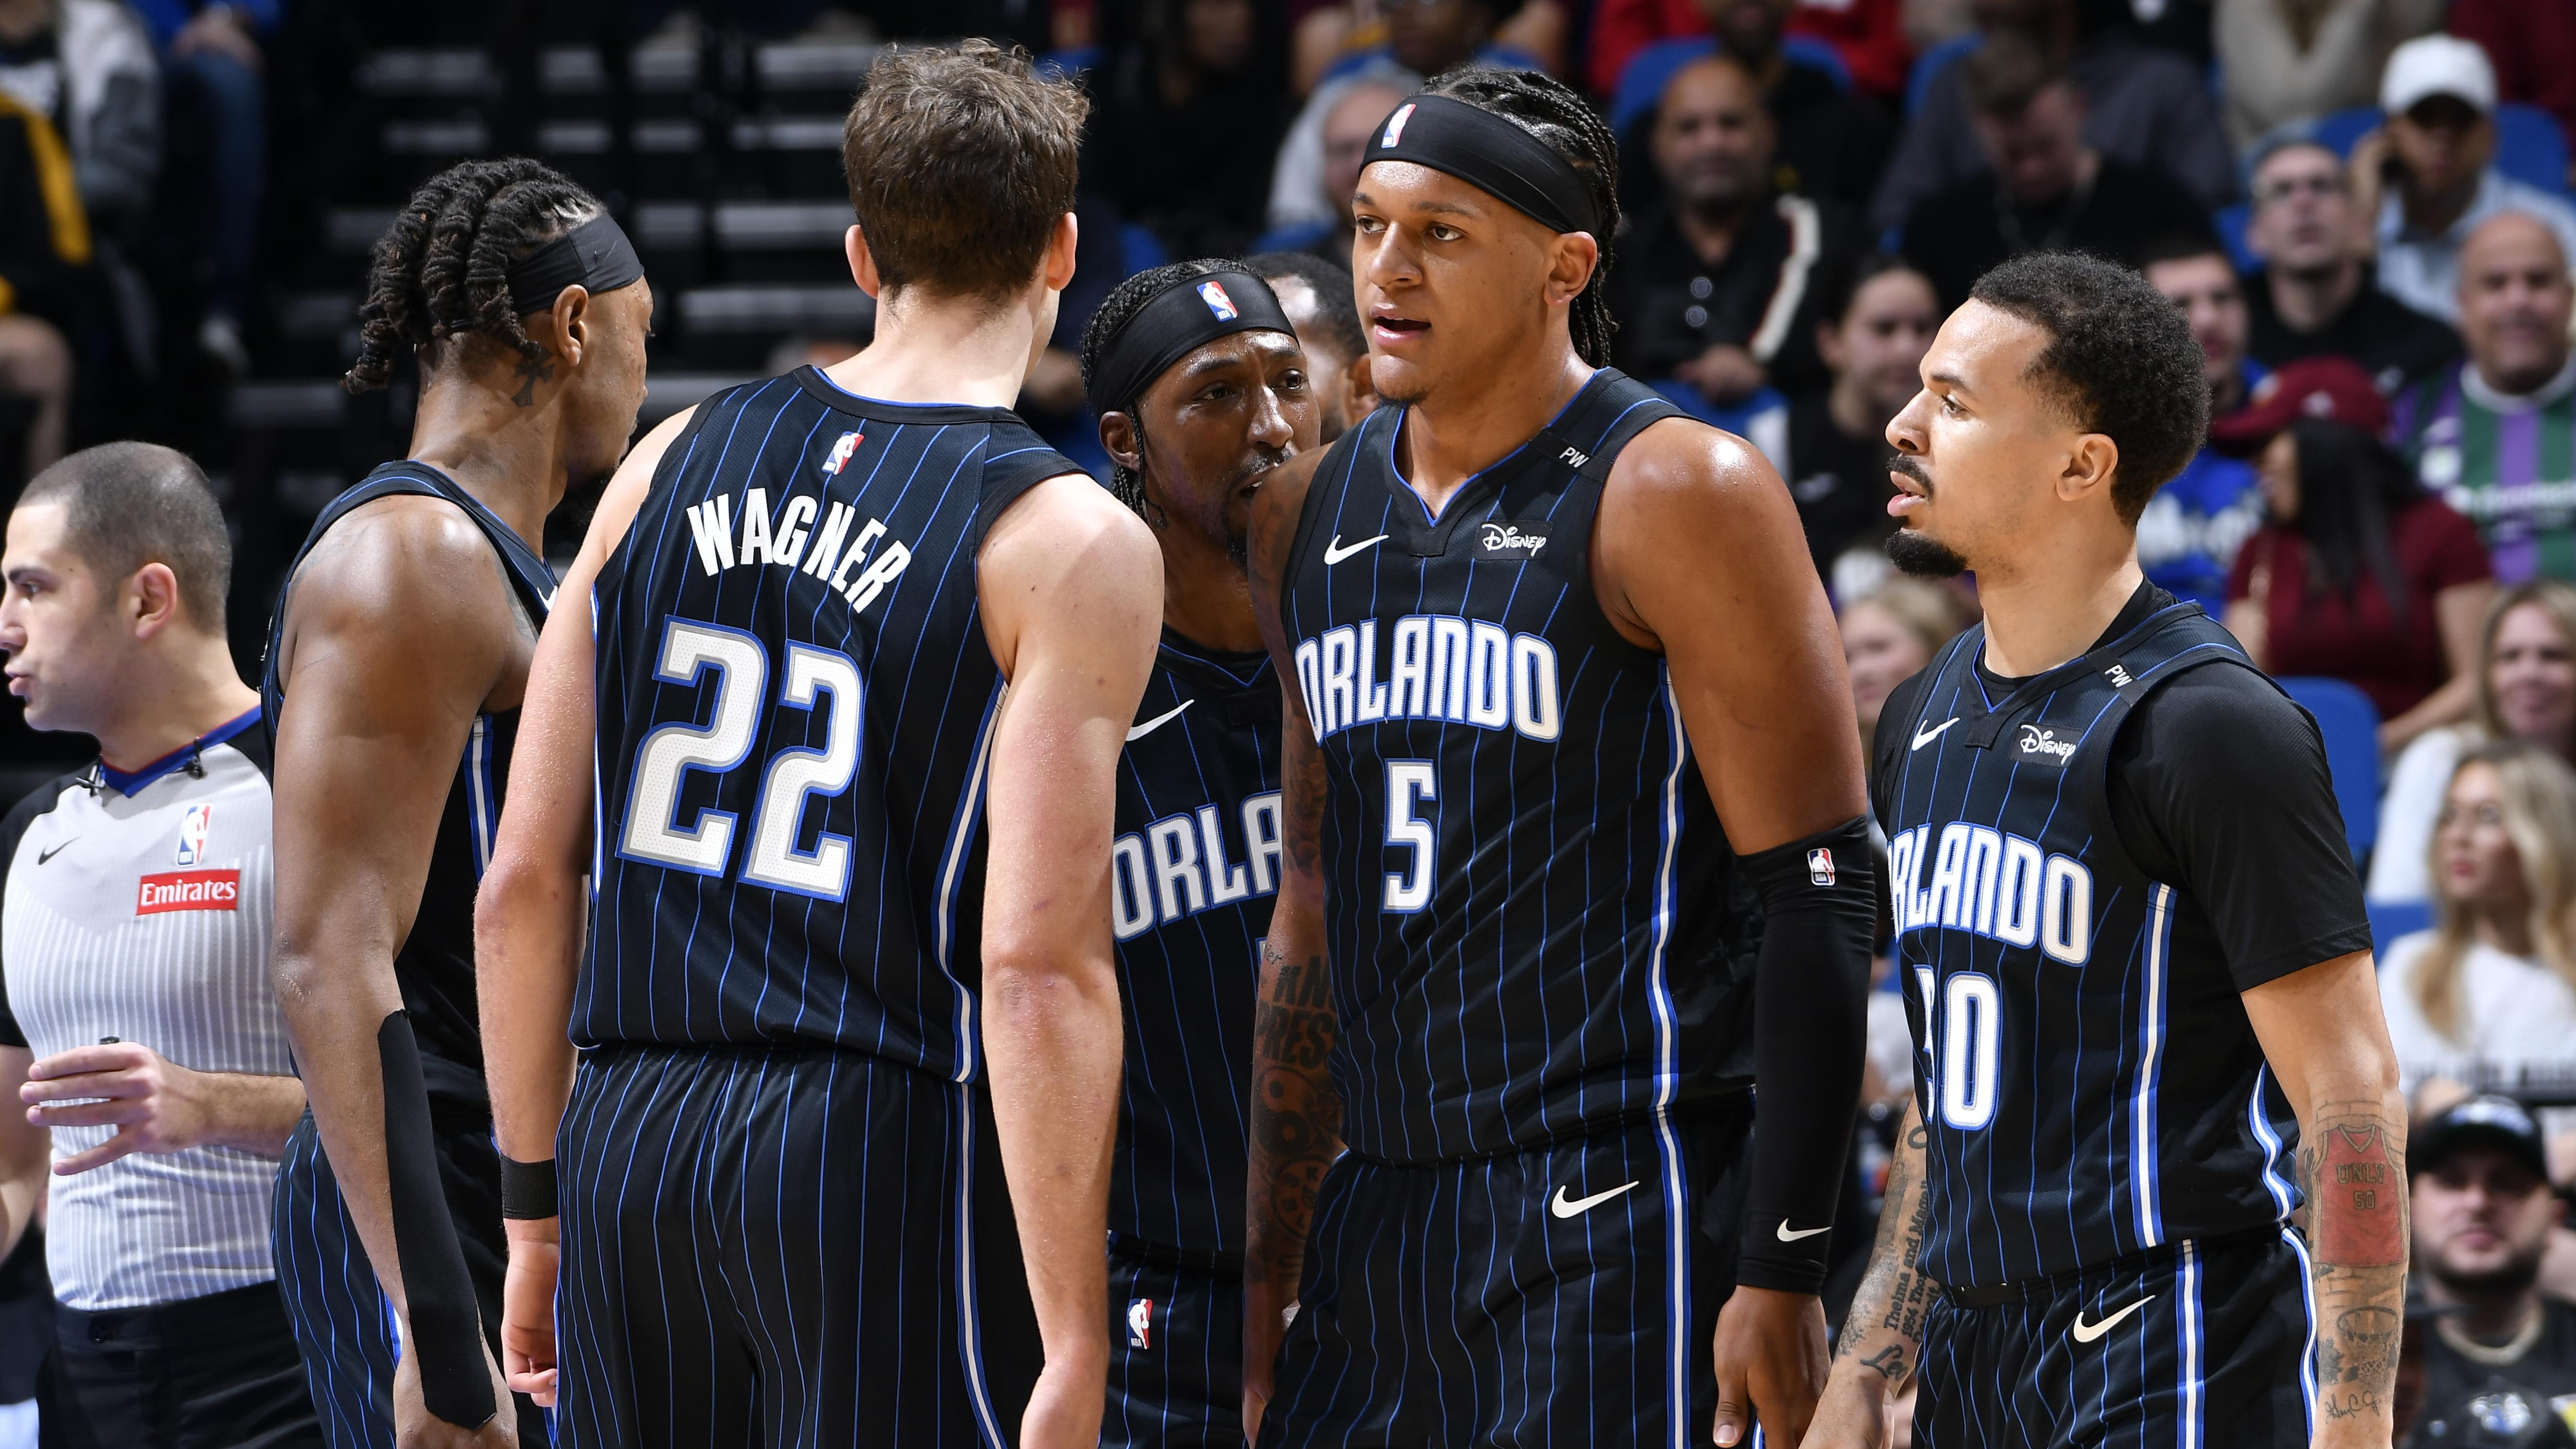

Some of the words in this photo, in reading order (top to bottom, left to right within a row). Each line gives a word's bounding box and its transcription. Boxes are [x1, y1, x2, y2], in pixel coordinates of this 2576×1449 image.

[1559, 446, 1589, 468] PW
[687, 487, 911, 613] WAGNER
[1294, 614, 1562, 747] ORLANDO
[2105, 664, 2132, 687] PW
[615, 615, 863, 903] 22
[1381, 758, 1436, 914] 5
[141, 879, 236, 906] Emirates
[1887, 821, 2093, 967] RLANDO
[2336, 1162, 2385, 1184] UNLV
[2353, 1190, 2376, 1210] 50
[1884, 1272, 1911, 1330] Thelma
[1903, 1237, 1920, 1269] and
[1130, 1337, 1142, 1347] NBA
